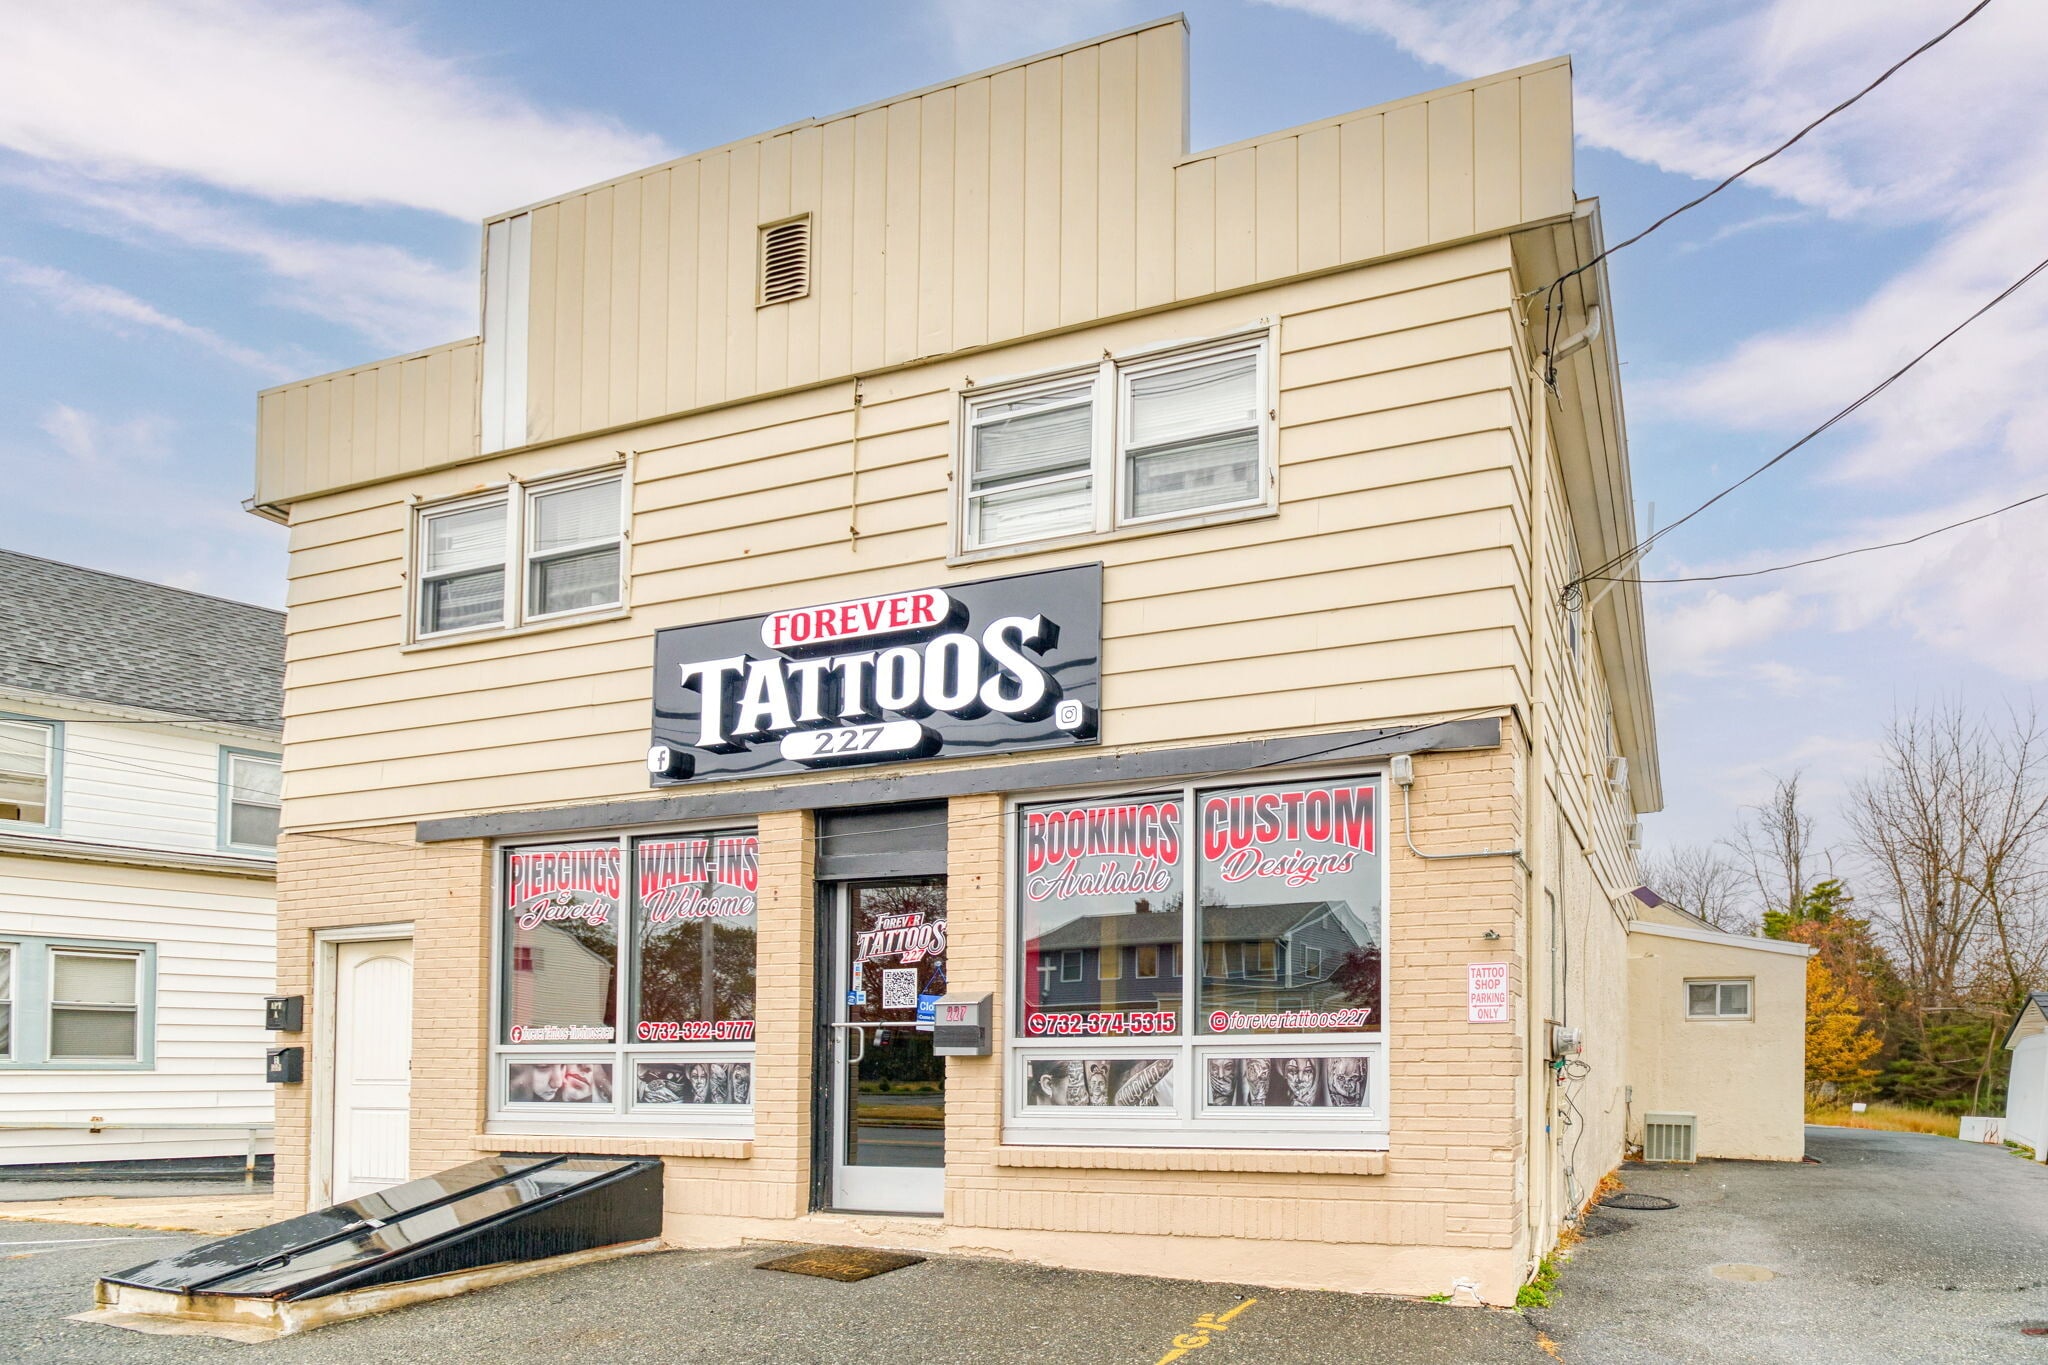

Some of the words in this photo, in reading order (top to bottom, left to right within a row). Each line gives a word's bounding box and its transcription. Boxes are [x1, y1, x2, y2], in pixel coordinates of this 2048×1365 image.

[772, 593, 936, 645] FOREVER
[679, 614, 1052, 748] TATTOOS
[812, 727, 885, 755] 227
[1203, 786, 1375, 861] CUSTOM
[1027, 803, 1180, 875] BOOKINGS
[509, 848, 620, 909] PIERCINGS
[639, 837, 759, 899] WALK-INS
[1027, 859, 1170, 901] Available
[1221, 847, 1356, 887] Designs
[557, 890, 572, 905] &
[643, 886, 755, 923] Welcome
[854, 919, 947, 962] TATTOOS
[902, 949, 925, 963] 227
[1471, 967, 1504, 978] TATTOO
[1475, 980, 1500, 990] SHOP
[1471, 993, 1505, 1003] PARKING
[946, 1005, 967, 1021] 227
[1046, 1012, 1175, 1034] 732-374-5315
[1230, 1008, 1371, 1030] forevertattoos227
[1478, 1008, 1499, 1019] ONLY
[651, 1021, 755, 1040] 732-322-9777
